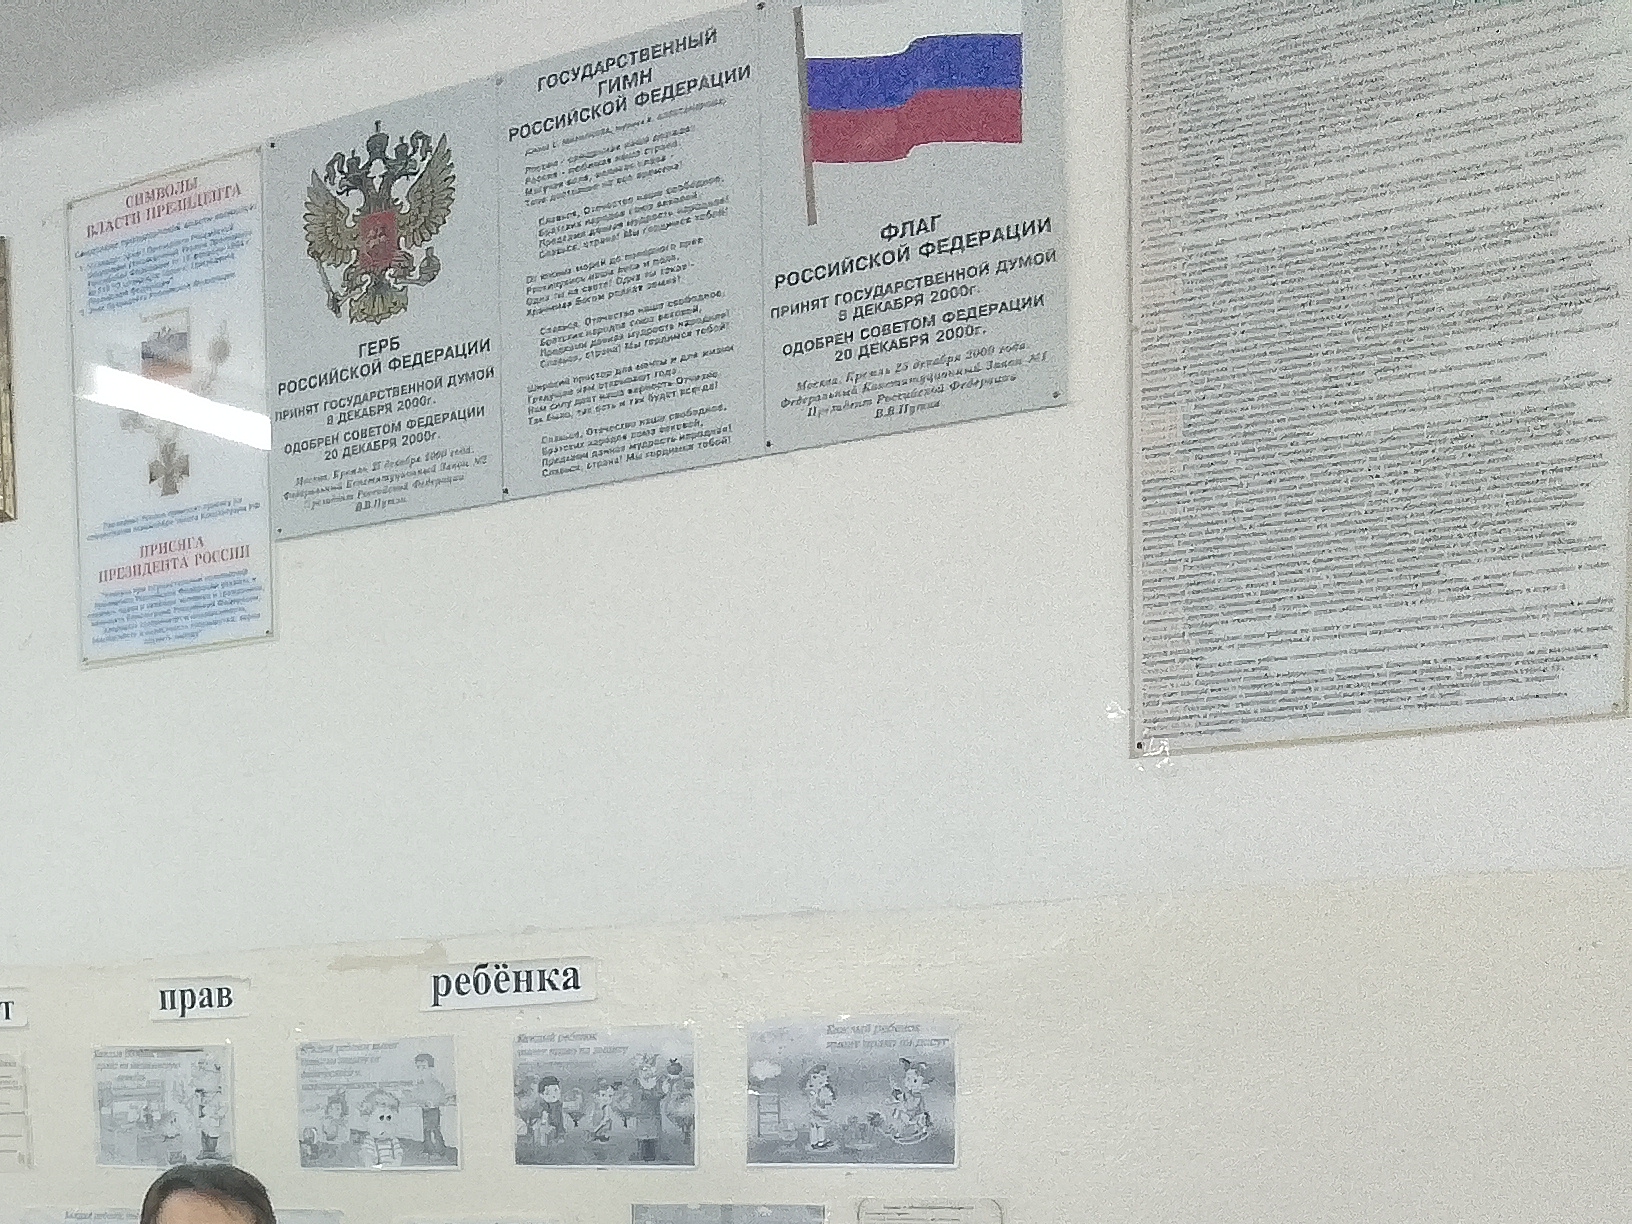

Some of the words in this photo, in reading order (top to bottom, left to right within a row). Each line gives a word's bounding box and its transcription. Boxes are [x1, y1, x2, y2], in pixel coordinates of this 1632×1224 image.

[537, 26, 717, 92] ГОСУДАРСТВЕННЫЙ
[598, 68, 652, 97] ГИМН
[508, 95, 627, 142] РОССИЙСКОЙ
[635, 65, 751, 107] ФЕДЕРАЦИИ
[880, 214, 941, 242] ФЛАГ
[775, 243, 910, 289] РОССИЙСКОЙ
[919, 217, 1052, 258] ФЕДЕРАЦИИ
[770, 296, 829, 319] ПРИНЯТ
[834, 260, 990, 306] ГОСУДАРСТВЕННОЙ
[995, 248, 1056, 275] ДУМОЙ
[853, 293, 924, 321] ДЕКАБРЯ
[930, 284, 981, 303] 2000г.
[358, 336, 401, 358] ГЕРБ
[782, 331, 854, 357] ОДОБРЕН
[860, 314, 936, 340] СОВЕТОМ
[942, 294, 1045, 323] ФЕДЕРАЦИИ
[834, 348, 852, 361] 20
[858, 333, 929, 360] ДЕКАБРЯ
[935, 324, 987, 343] 2000г.
[277, 358, 382, 396] РОССИЙСКОЙ
[388, 337, 491, 372] ФЕДЕРАЦИИ
[274, 402, 319, 422] ПРИНЯТ
[323, 376, 443, 412] ГОСУДАРСТВЕННОЙ
[446, 366, 496, 389] ДУМОЙ
[337, 403, 393, 426] ДЕКАБРЯ
[397, 395, 437, 412] 2000г.
[284, 432, 340, 455] ОДОБРЕН
[343, 421, 402, 442] СОВЕТОМ
[406, 406, 486, 431] ФЕДЕРАЦИИ
[324, 449, 338, 461] 20
[342, 437, 398, 460] ДЕКАБРЯ
[401, 430, 441, 447] 2000г.
[98, 556, 189, 584] ПРЕЗИДЕНТА
[158, 984, 233, 1013] прав
[430, 962, 581, 1007] ребёнка
